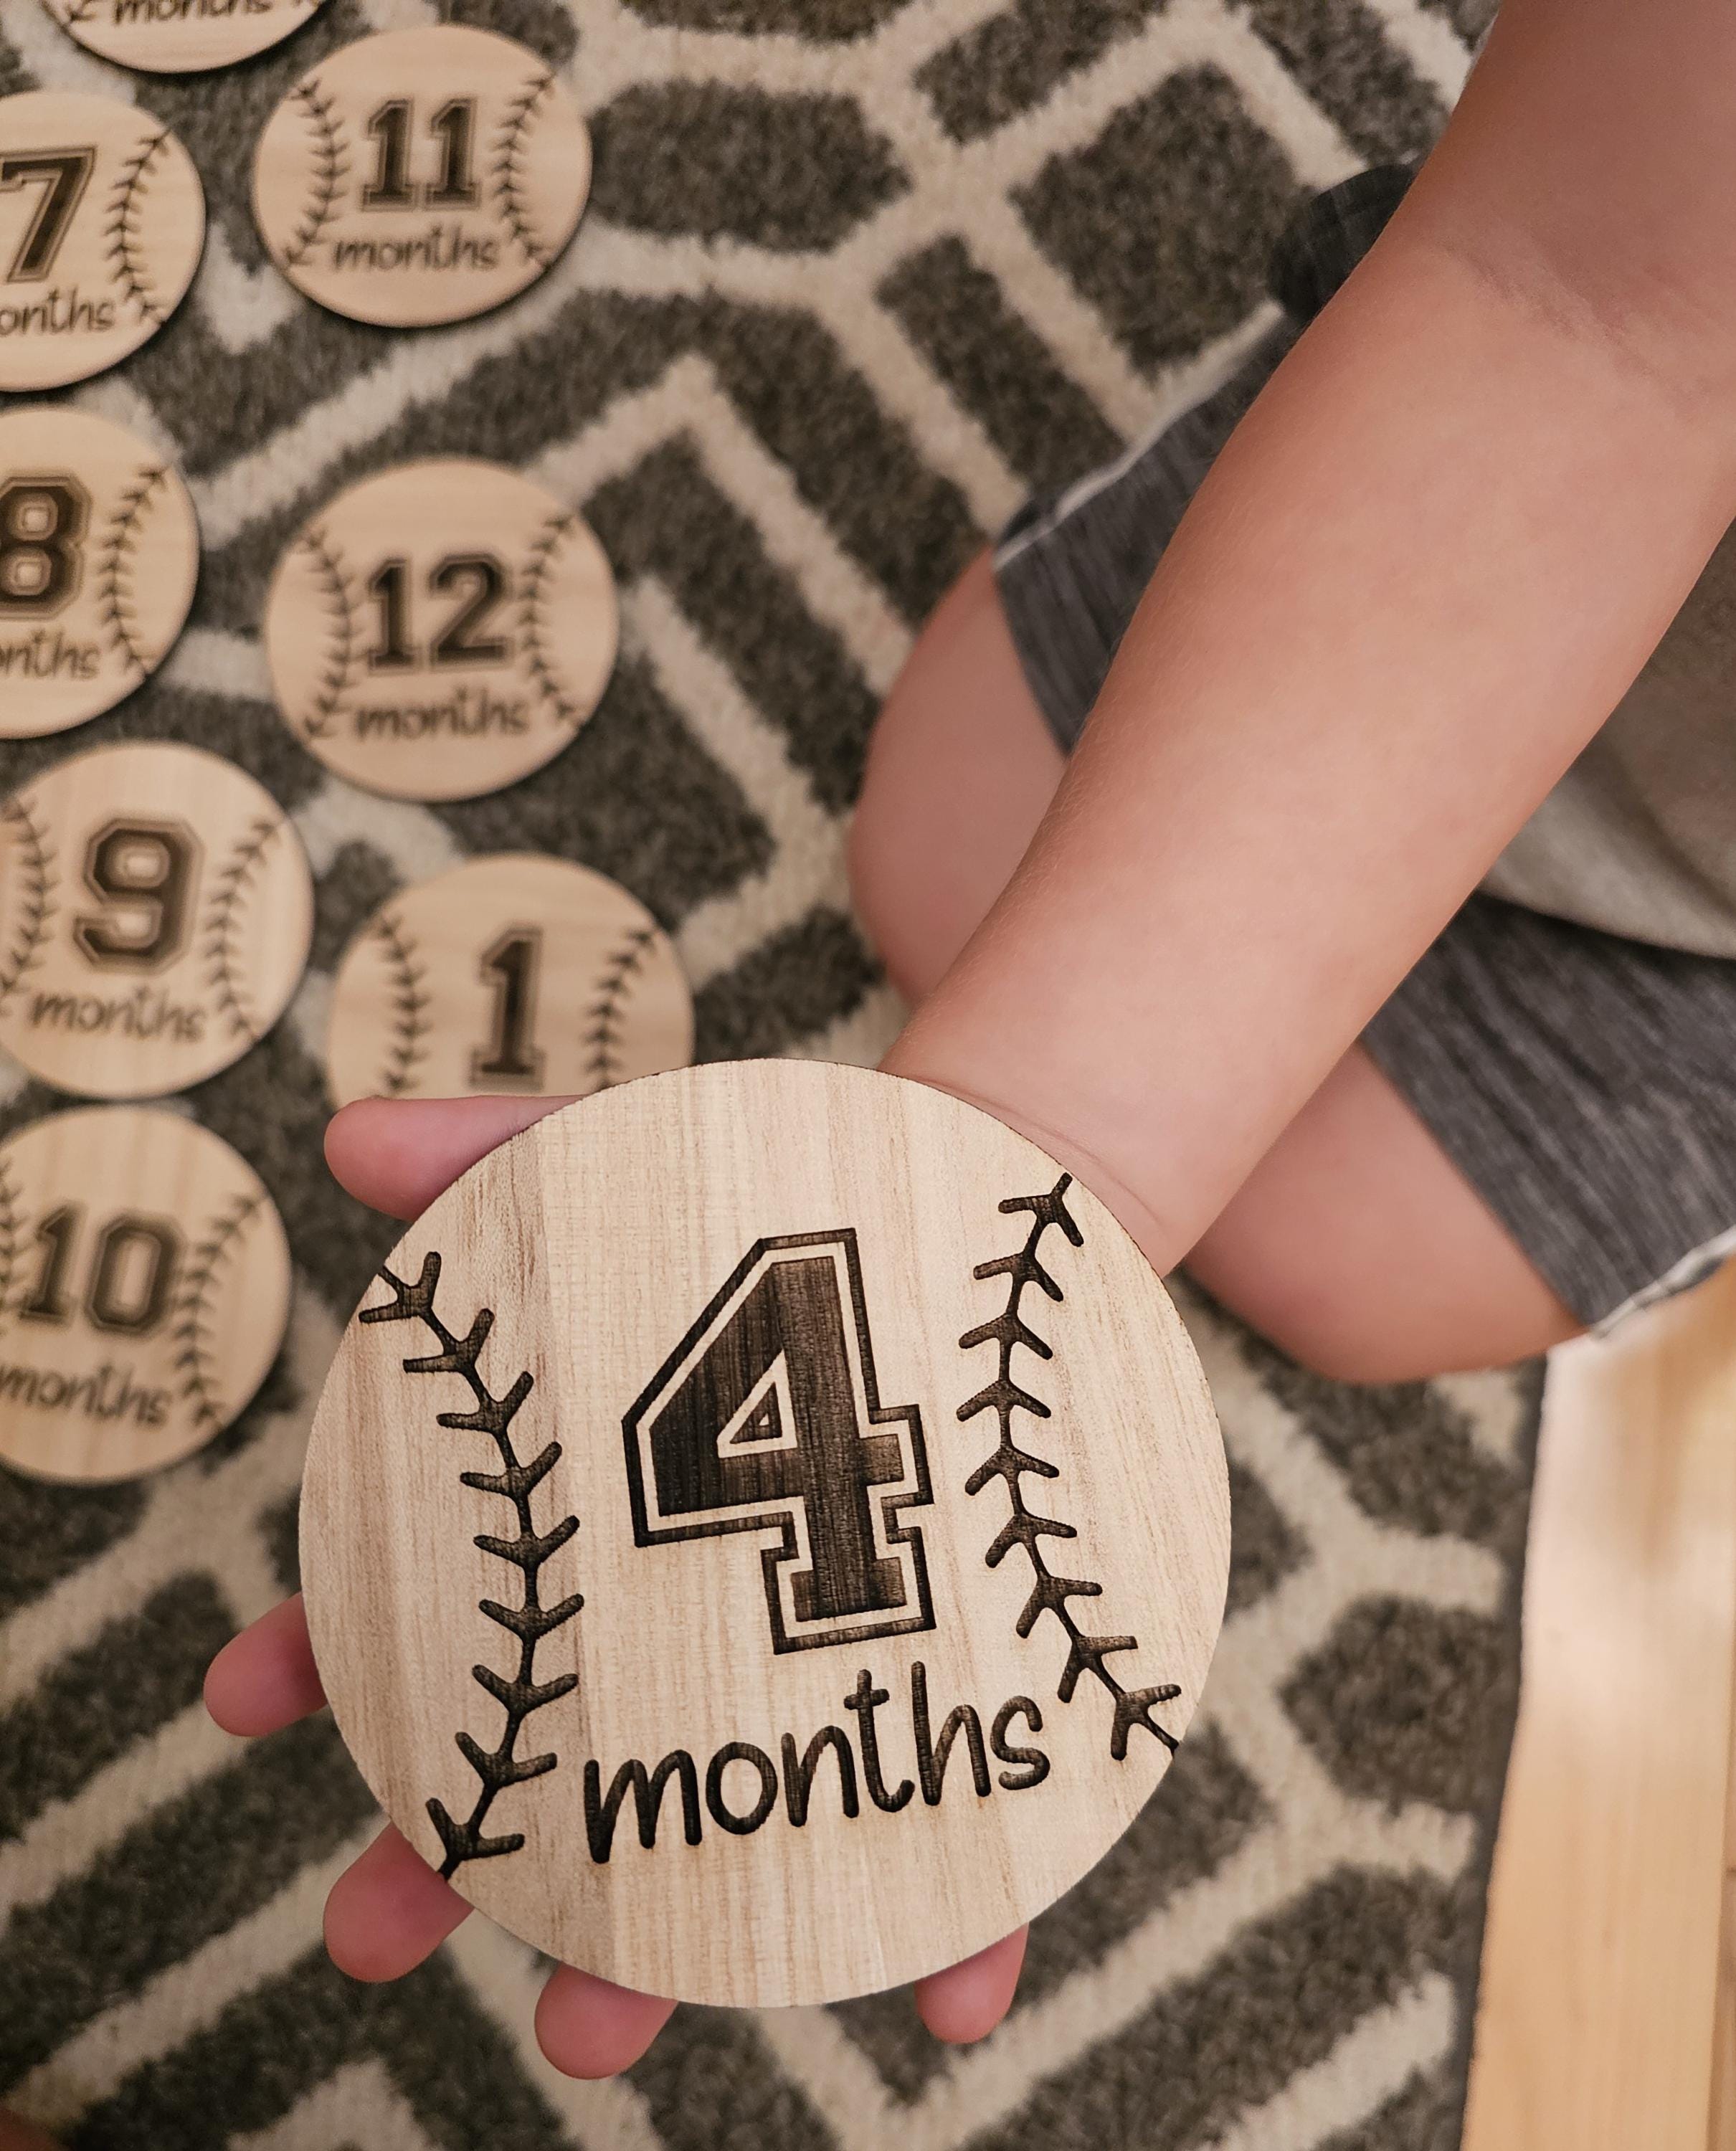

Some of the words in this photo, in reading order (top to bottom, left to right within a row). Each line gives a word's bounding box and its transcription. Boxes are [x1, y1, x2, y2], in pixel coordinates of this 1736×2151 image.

[0, 146, 96, 282] 7
[362, 98, 480, 211] 11
[334, 222, 498, 270] months
[0, 288, 115, 335] onths
[0, 475, 93, 619] 8
[0, 628, 100, 680] nths
[367, 551, 513, 673] 12
[356, 685, 529, 740] months
[74, 812, 201, 974] 9
[29, 984, 206, 1043] months
[469, 922, 546, 1093] 1
[19, 1201, 185, 1339] 10
[0, 1362, 172, 1428] months
[622, 1228, 936, 1655] 4
[583, 1661, 1049, 1863] months
